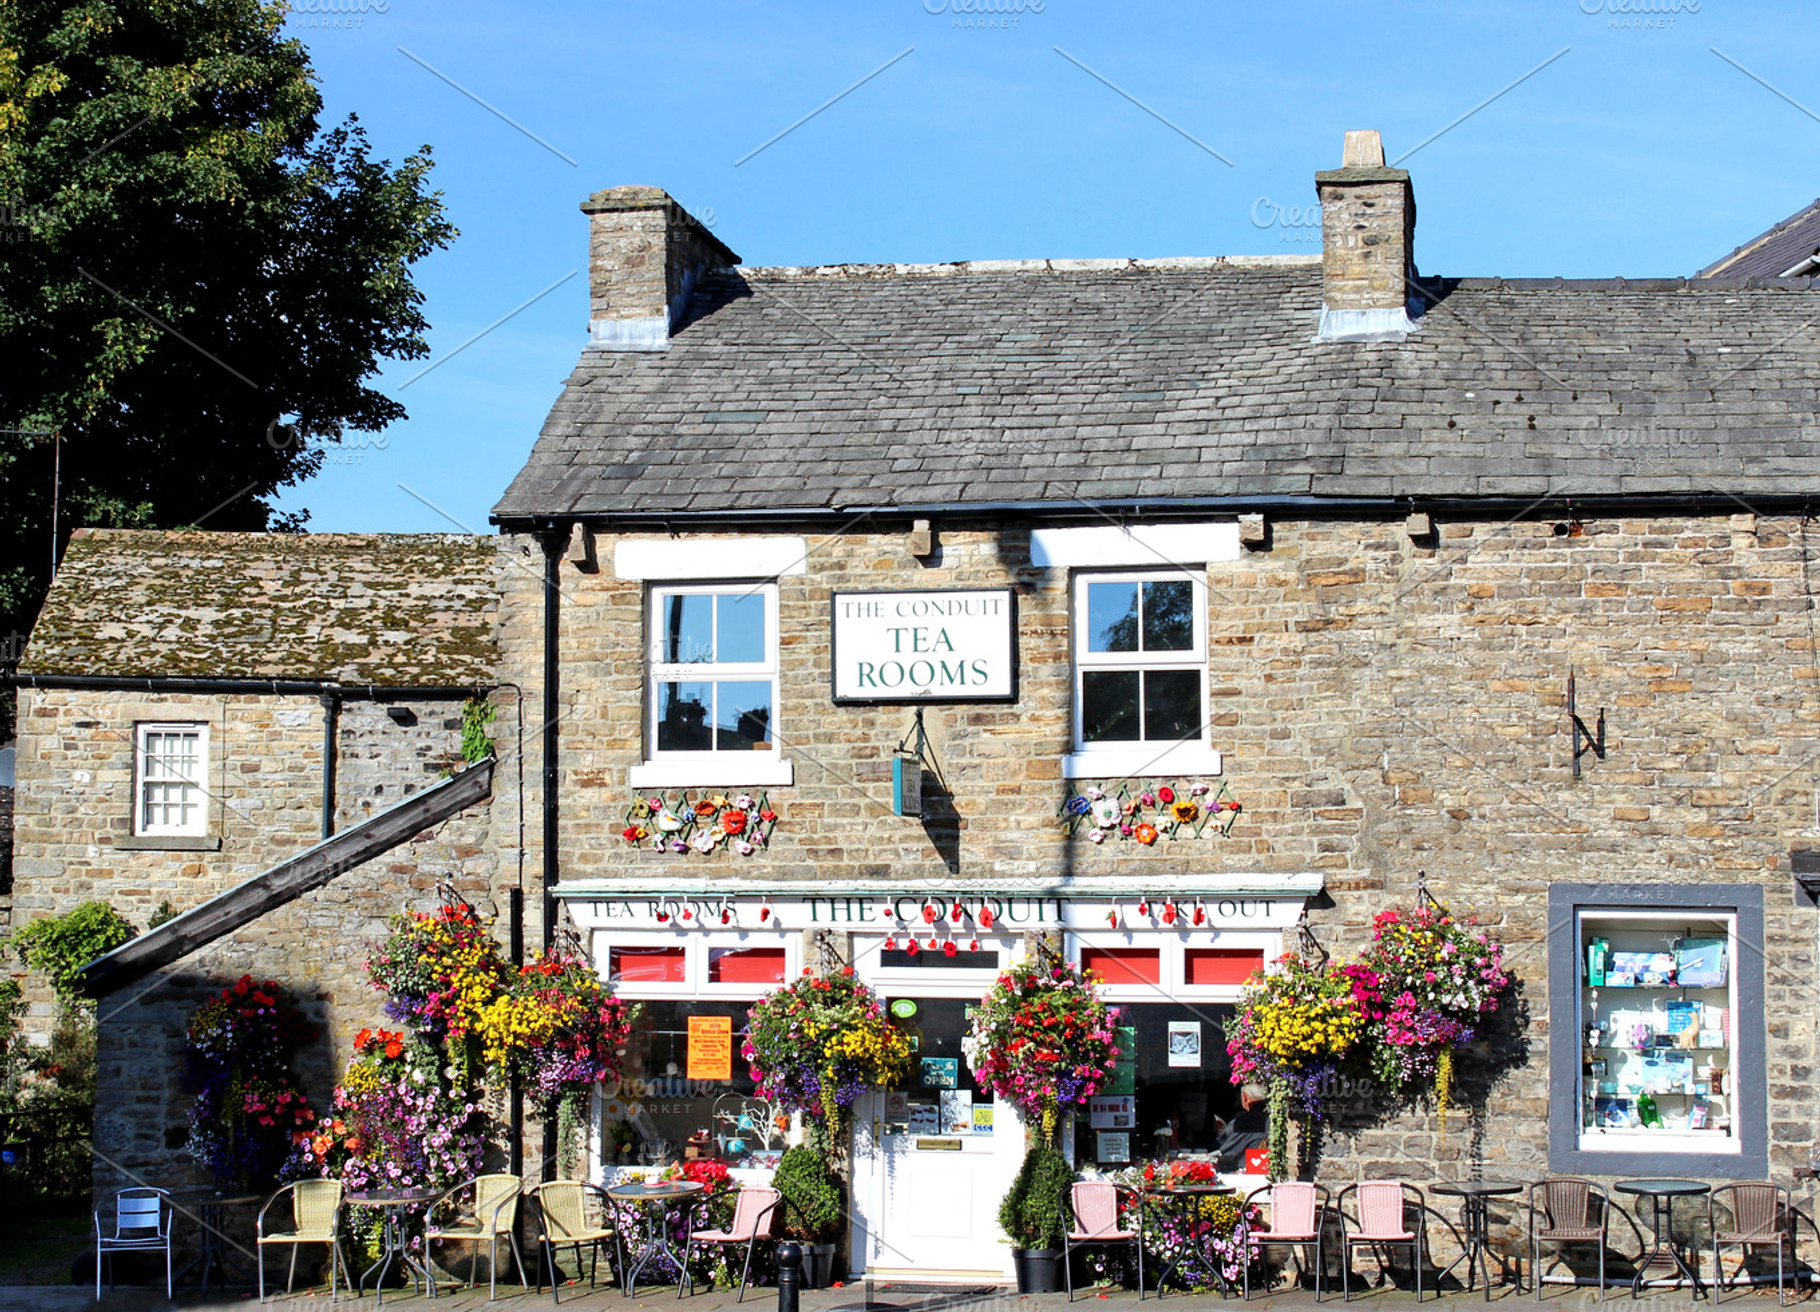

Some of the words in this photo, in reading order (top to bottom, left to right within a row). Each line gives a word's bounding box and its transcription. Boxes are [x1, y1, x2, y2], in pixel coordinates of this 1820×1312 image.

[840, 602, 885, 618] THE
[896, 599, 1003, 618] CONDUIT
[886, 627, 955, 653] TEA
[857, 659, 988, 688] ROOMS
[588, 901, 634, 918] TEA
[648, 900, 737, 918] ROOMS
[802, 897, 877, 922] THE
[894, 897, 1071, 922] CONDUIT
[1218, 900, 1276, 918] OUT
